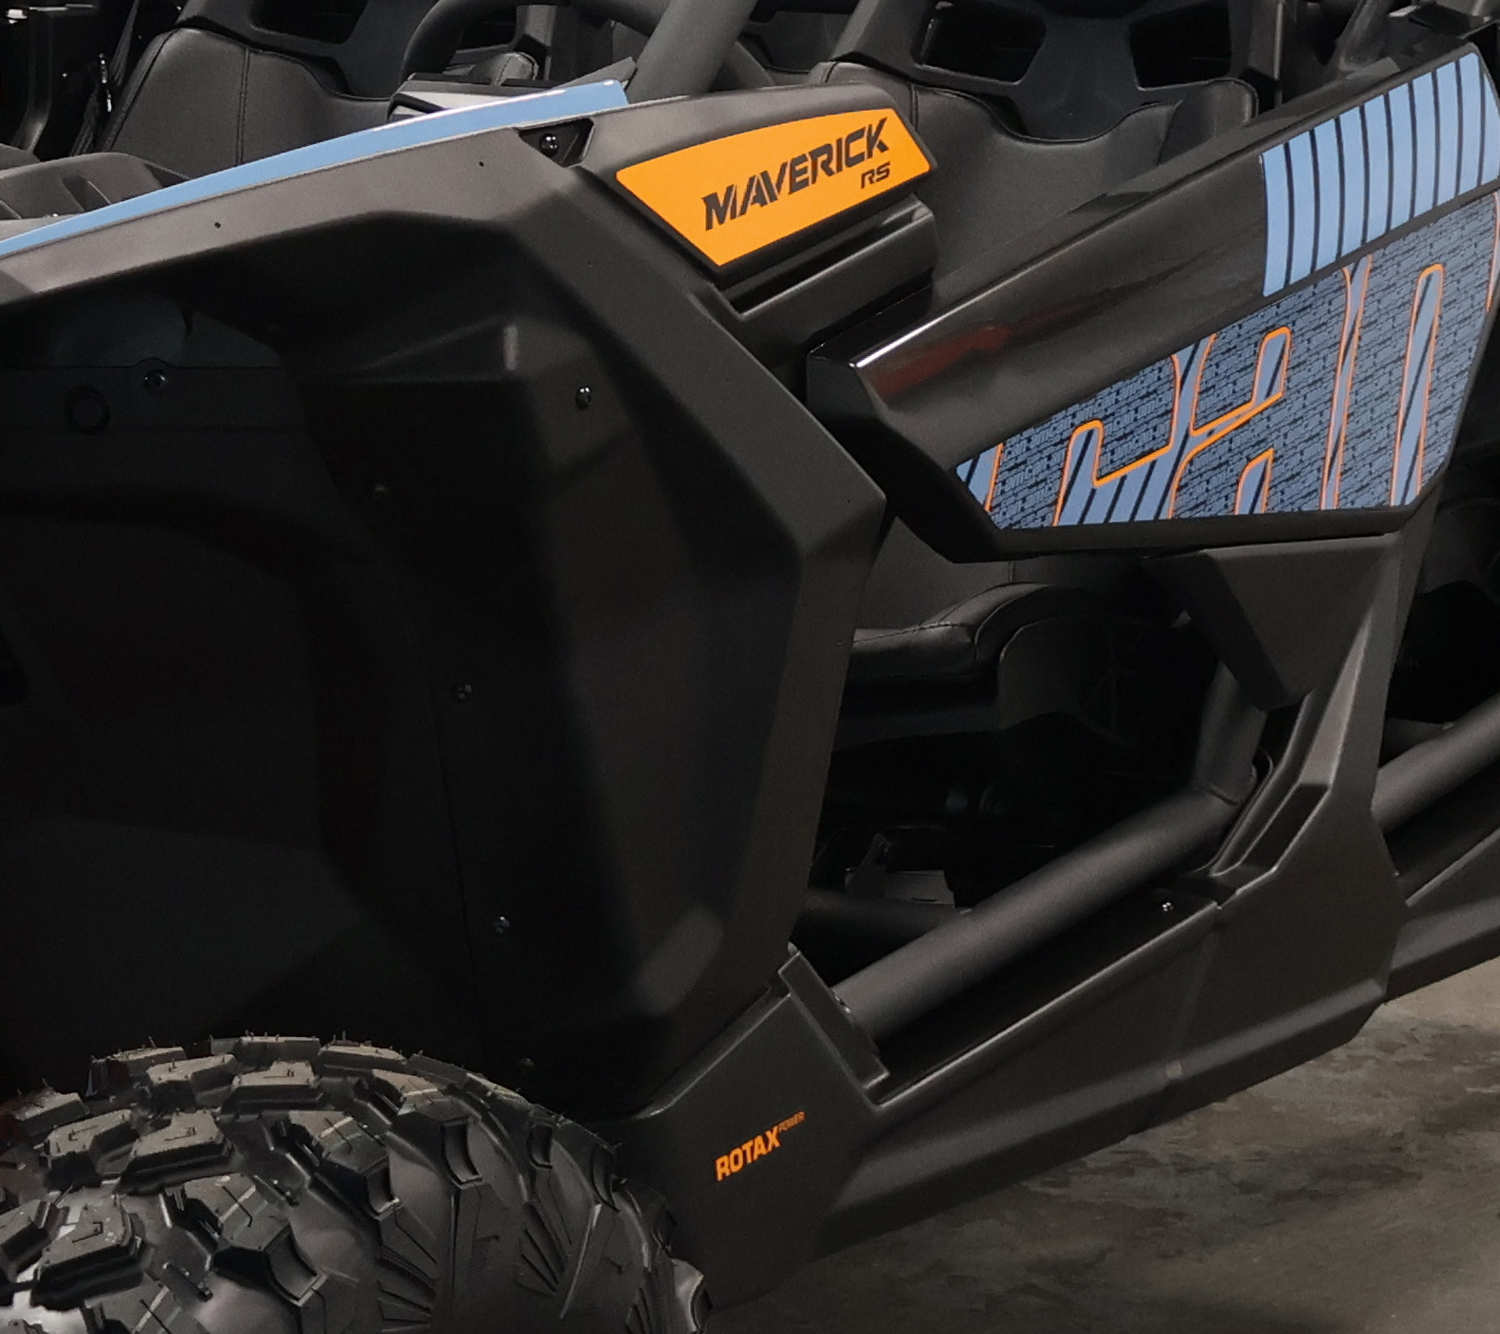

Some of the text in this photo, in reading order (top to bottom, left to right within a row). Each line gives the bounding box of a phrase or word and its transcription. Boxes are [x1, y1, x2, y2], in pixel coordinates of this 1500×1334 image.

[701, 117, 889, 231] MAVERICK
[861, 162, 892, 189] RS
[715, 1125, 781, 1181] ROTAX
